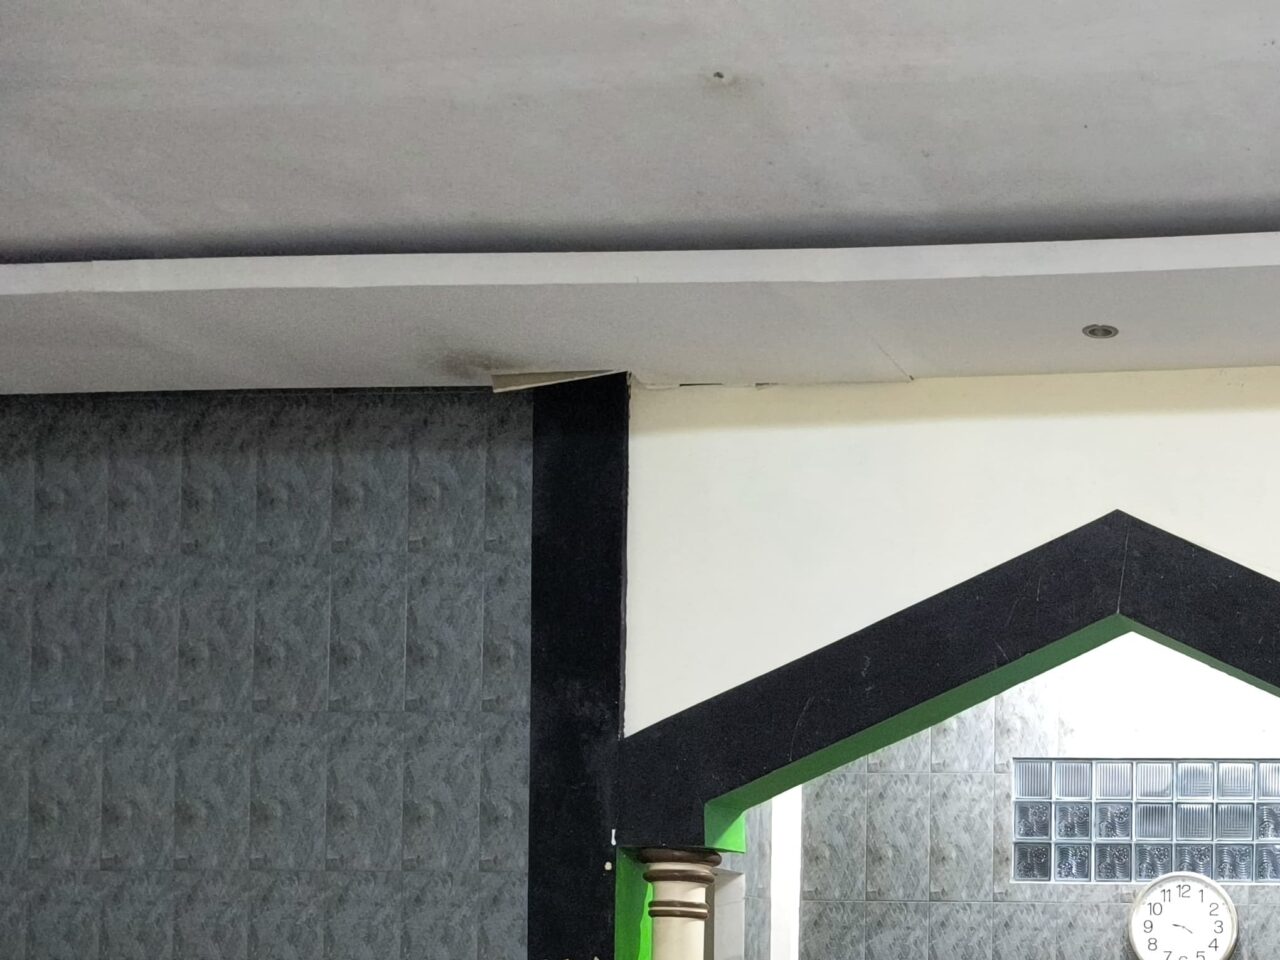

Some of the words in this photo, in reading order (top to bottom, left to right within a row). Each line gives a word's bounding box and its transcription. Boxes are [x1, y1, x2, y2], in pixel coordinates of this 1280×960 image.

[1160, 889, 1171, 902] 11
[1176, 884, 1191, 898] 12
[1198, 889, 1204, 903] 1
[1147, 902, 1163, 916] 10
[1209, 902, 1219, 916] 2
[1143, 919, 1153, 933] 9
[1213, 920, 1224, 934] 3
[1147, 937, 1158, 951] 8
[1208, 938, 1219, 951] 4
